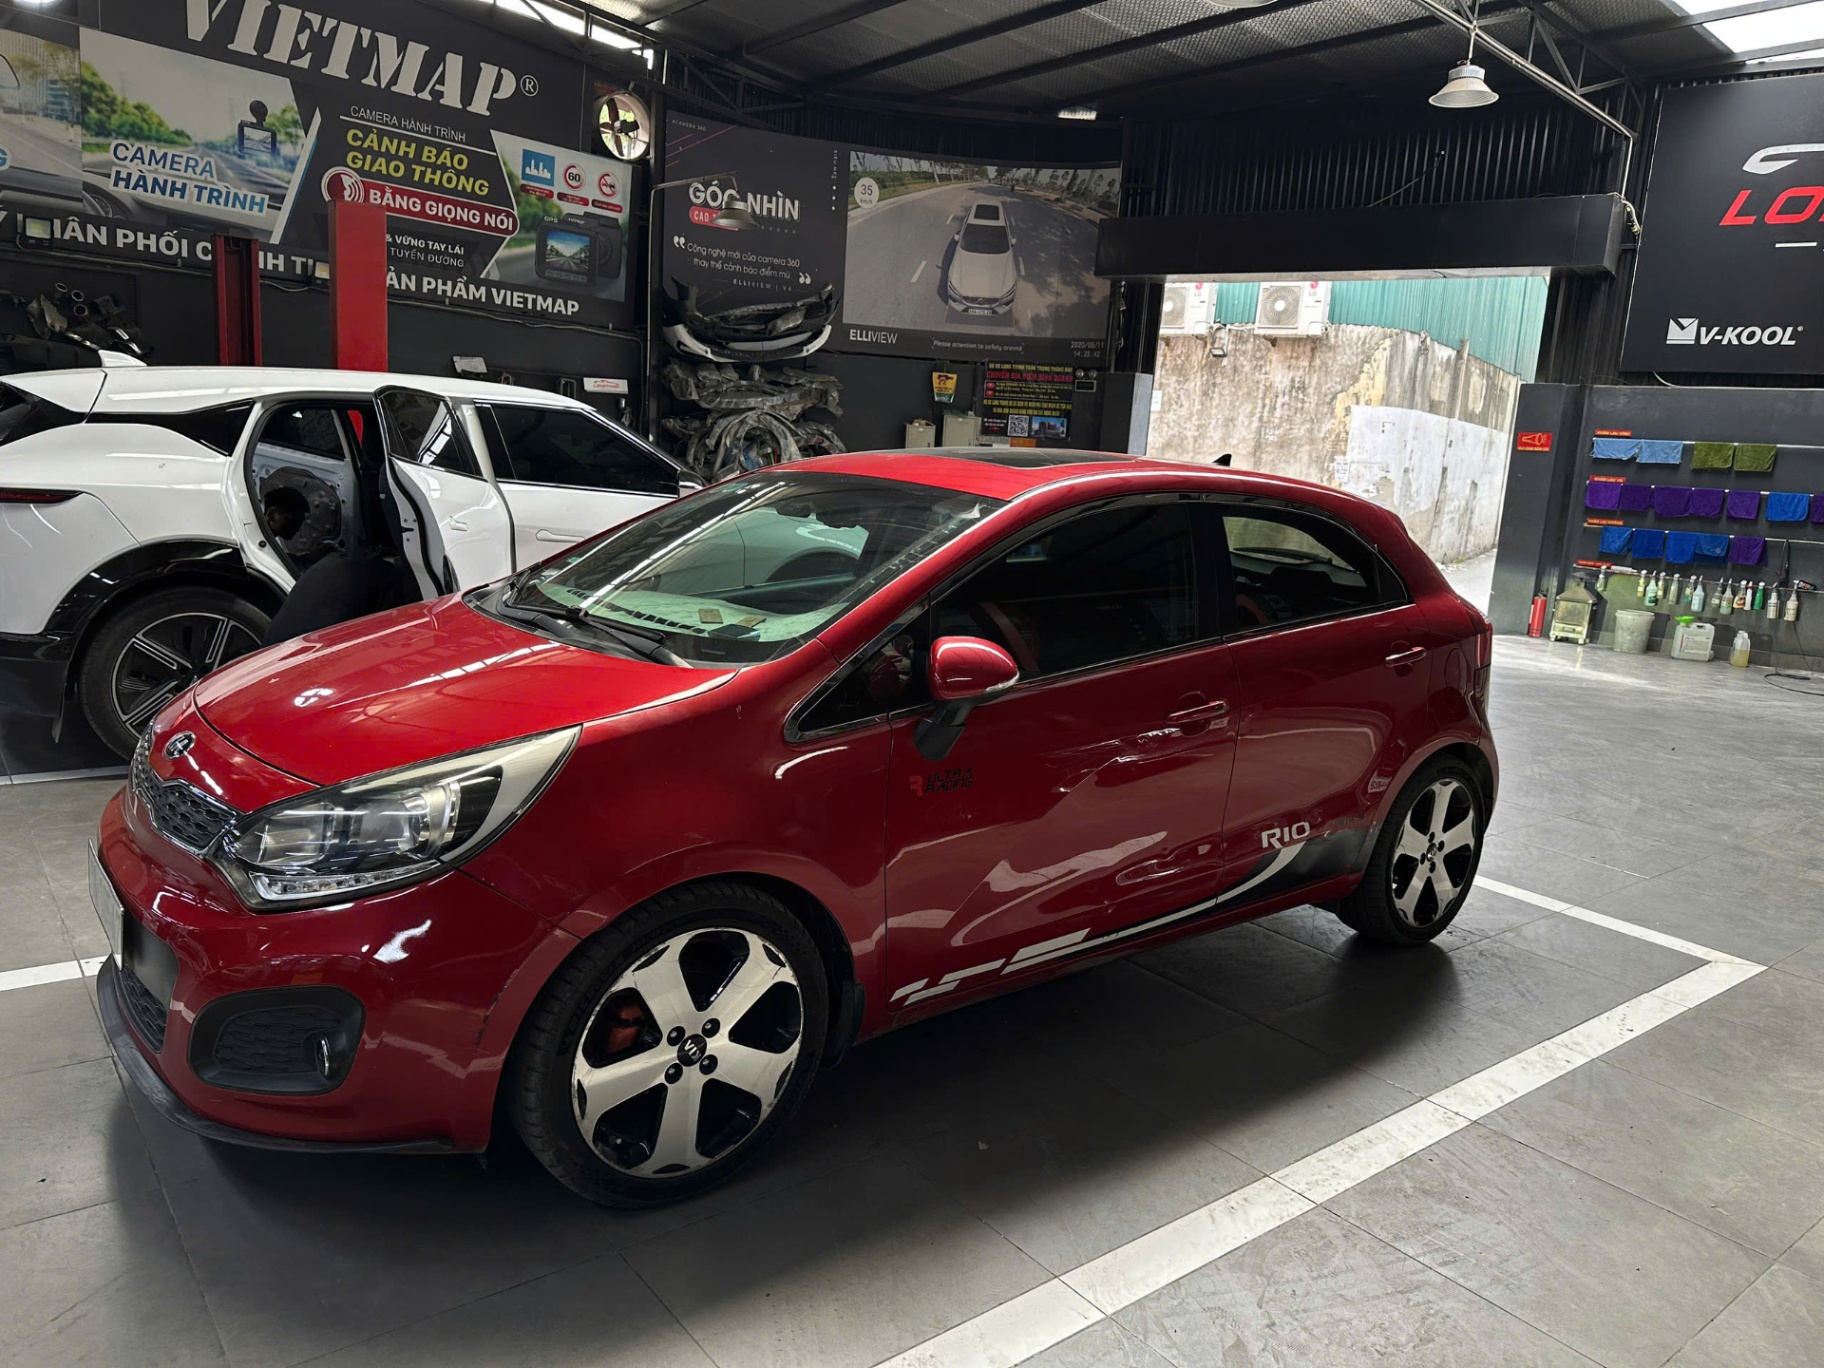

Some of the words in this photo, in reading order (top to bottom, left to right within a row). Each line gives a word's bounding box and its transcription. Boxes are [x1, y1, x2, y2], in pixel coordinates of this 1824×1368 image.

[350, 105, 399, 127] CAMERA
[401, 117, 432, 135] HÀNH
[434, 125, 466, 143] TRÌNH
[112, 142, 215, 178] CAMERA
[346, 128, 416, 159] CẢNH
[421, 145, 469, 171] BÁO
[346, 151, 405, 178] GIAO
[411, 164, 490, 196] THÔNG
[568, 171, 581, 183] 60
[112, 169, 188, 200] HÀNH
[194, 184, 266, 214] TRÌNH
[860, 184, 873, 196] 35
[369, 185, 421, 212] BẰNG
[425, 200, 480, 223] GIỌNG
[484, 209, 514, 231] NÓI
[693, 210, 710, 221] CAO
[747, 190, 800, 222] NHÌN
[1719, 186, 1824, 226] LO
[116, 228, 188, 258] PHỐI
[395, 234, 425, 248] VỮNG
[427, 240, 447, 252] TAY
[448, 244, 464, 255] LÁI
[687, 242, 707, 256] Công
[707, 246, 726, 258] nghệ
[727, 248, 740, 259] mới
[742, 251, 757, 262] của
[757, 254, 786, 266] camera
[787, 257, 800, 268] 360
[390, 247, 425, 261] TUYẾN
[427, 253, 464, 268] ĐƯỜNG
[693, 257, 709, 269] thay
[710, 257, 723, 269] thế
[723, 260, 742, 272] cảnh
[743, 265, 758, 275] báo
[386, 266, 416, 292] ẢN
[422, 275, 486, 302] PHẨM
[492, 290, 580, 316] VIETMAP
[849, 329, 898, 344] ELLIVIEW
[933, 340, 951, 348] Please
[925, 776, 974, 794] RACING
[927, 767, 973, 783] ULTRA
[1261, 821, 1311, 849] RIO
